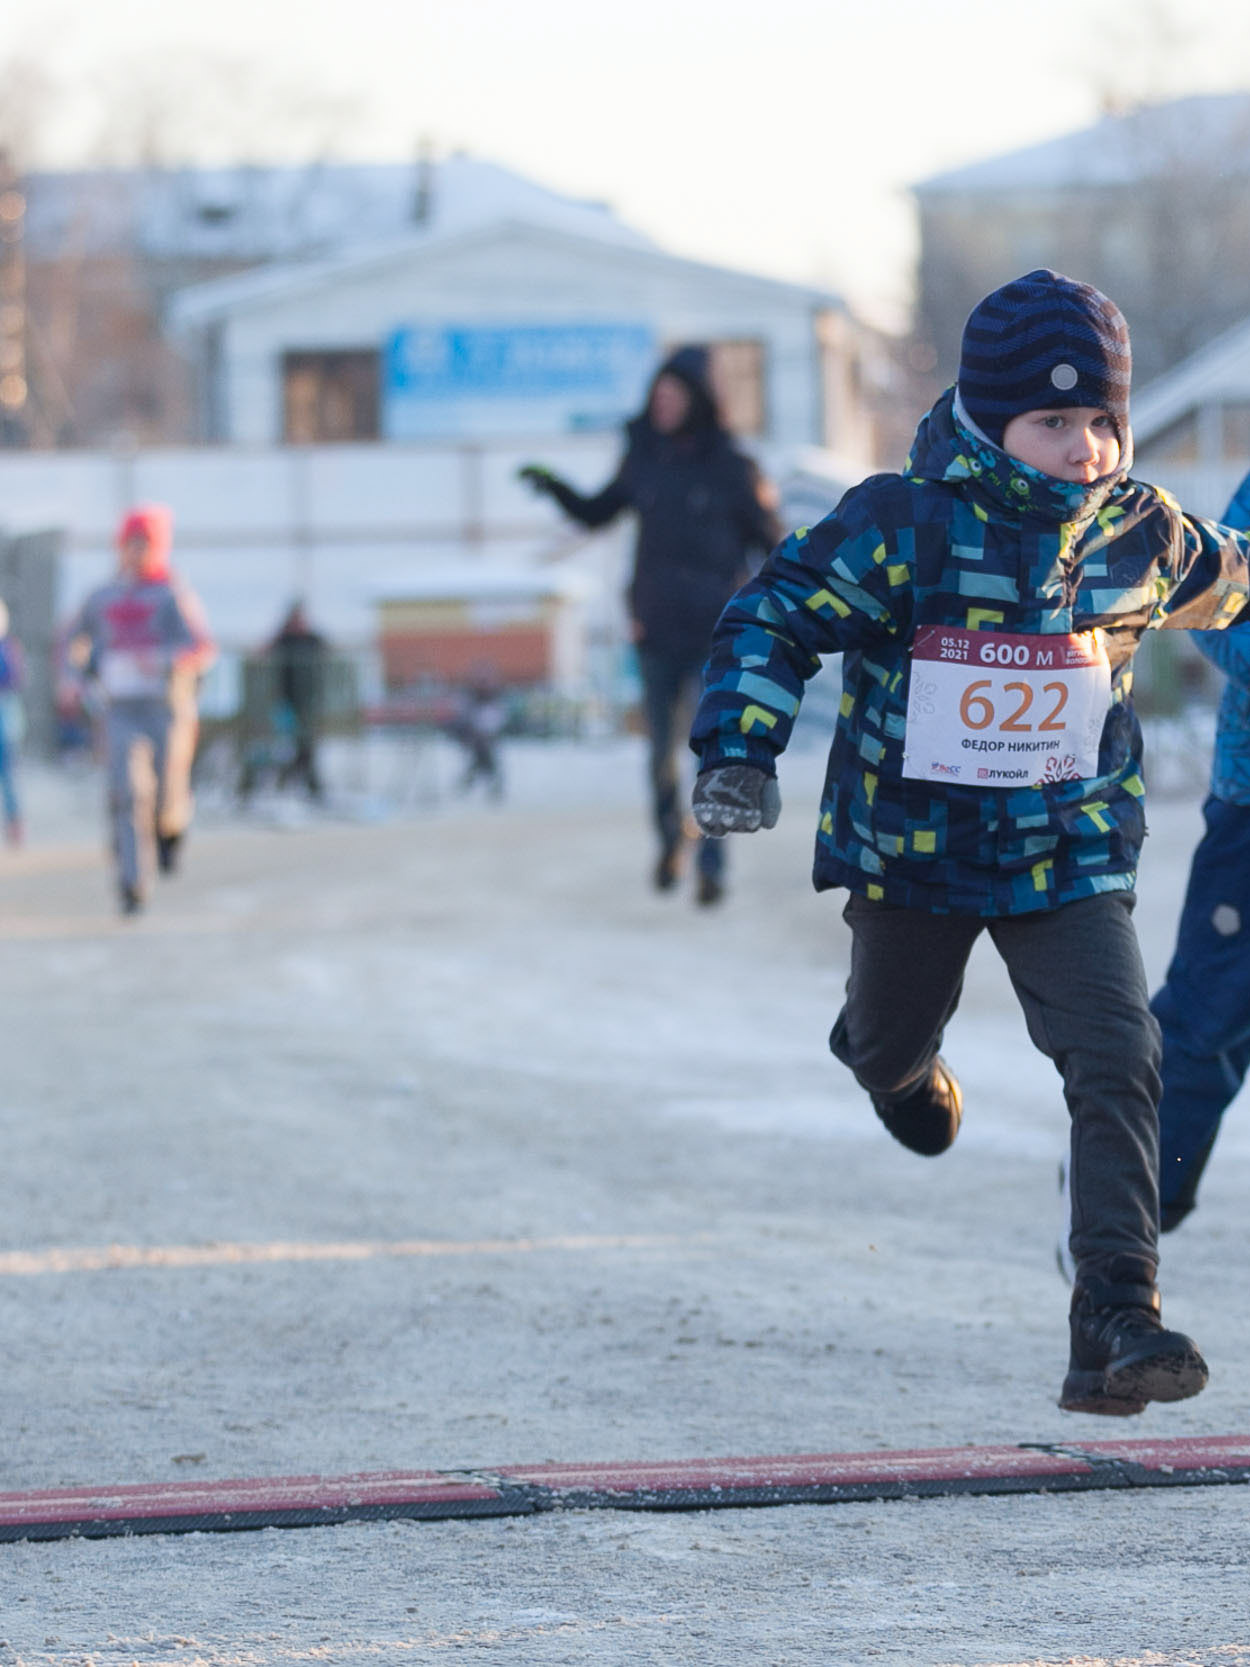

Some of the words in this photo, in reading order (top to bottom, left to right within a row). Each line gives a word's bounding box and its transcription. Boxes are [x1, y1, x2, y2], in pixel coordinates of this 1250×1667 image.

[941, 637, 970, 649] 05.12
[940, 648, 969, 660] 2021
[980, 643, 1030, 666] 600
[959, 680, 1070, 732] 622
[961, 738, 1006, 752] ФЕДОР
[1008, 740, 1061, 752] НИКИТИН
[988, 769, 1030, 779] ЛУКОЙЛ
